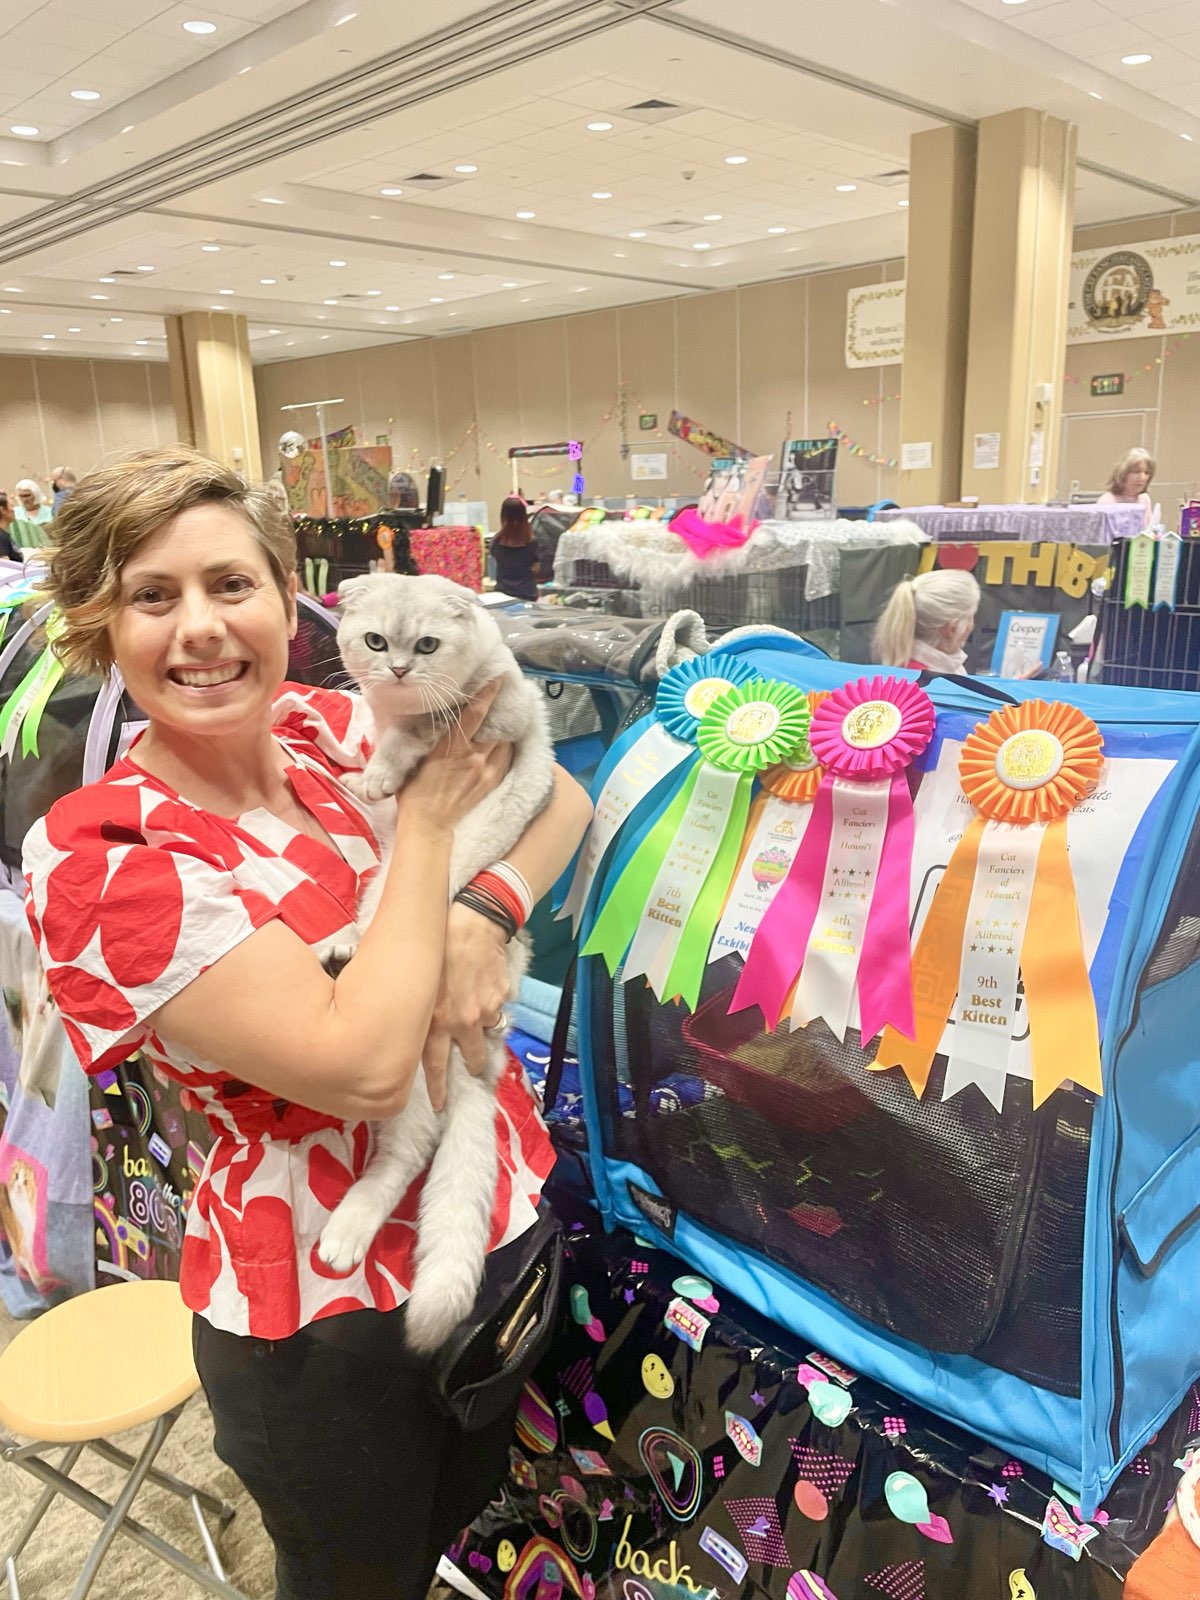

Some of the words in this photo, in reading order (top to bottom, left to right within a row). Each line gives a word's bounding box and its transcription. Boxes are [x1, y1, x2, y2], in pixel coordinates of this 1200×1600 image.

[1011, 622, 1044, 636] Cooper
[1072, 805, 1096, 814] Cats
[774, 823, 794, 836] CFA
[1000, 852, 1016, 862] Cat
[989, 865, 1025, 875] Fanciers
[1000, 877, 1010, 888] of
[665, 886, 682, 899] 7th
[657, 897, 682, 913] Best
[647, 907, 682, 928] Kitten
[975, 930, 1013, 941] Allbreed
[977, 975, 998, 989] 9th
[971, 994, 1002, 1009] Best
[962, 1009, 1008, 1026] Kitten
[615, 1514, 702, 1594] back
